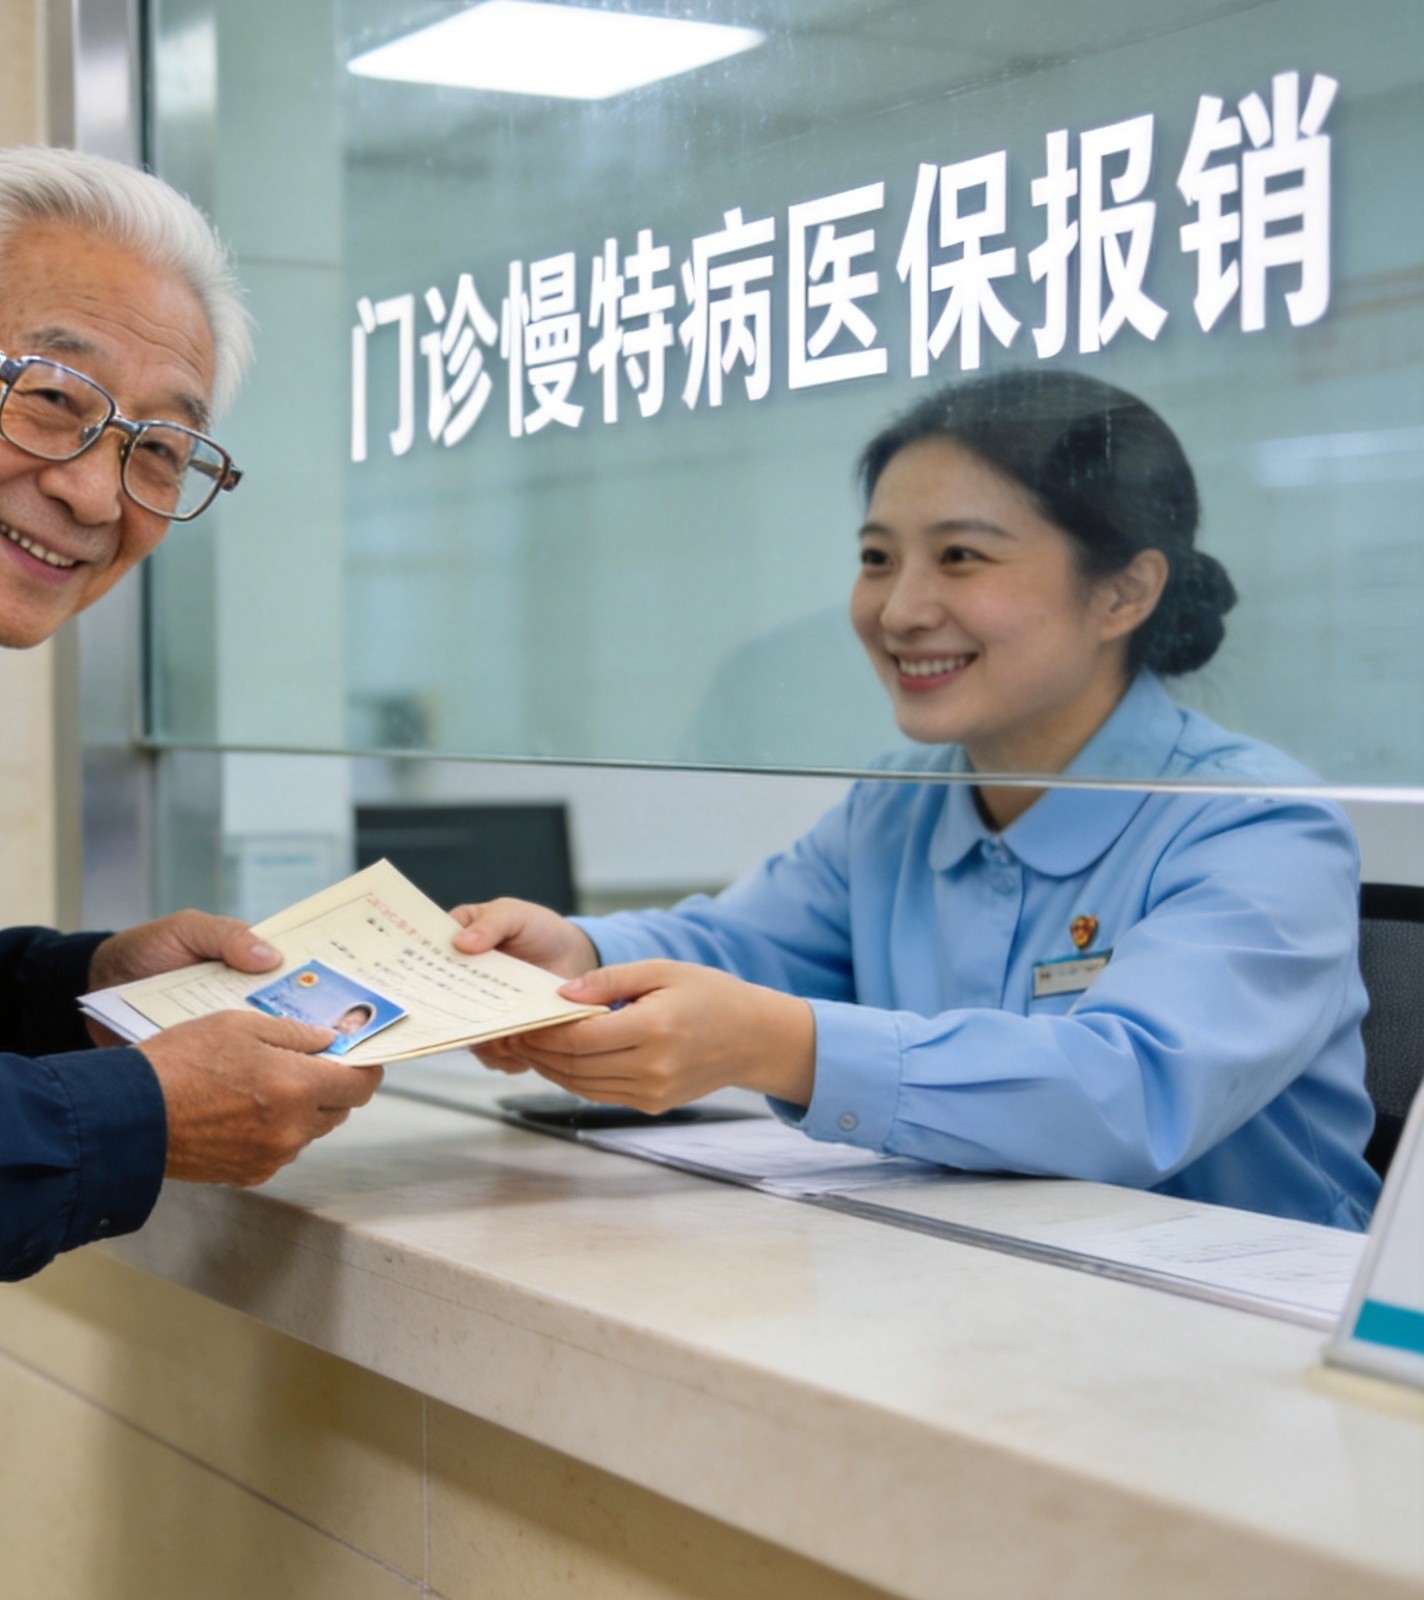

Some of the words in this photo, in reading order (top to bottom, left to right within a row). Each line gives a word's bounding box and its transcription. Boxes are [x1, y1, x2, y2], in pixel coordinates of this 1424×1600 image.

[350, 71, 1339, 462] 门诊慢特病医保报销
